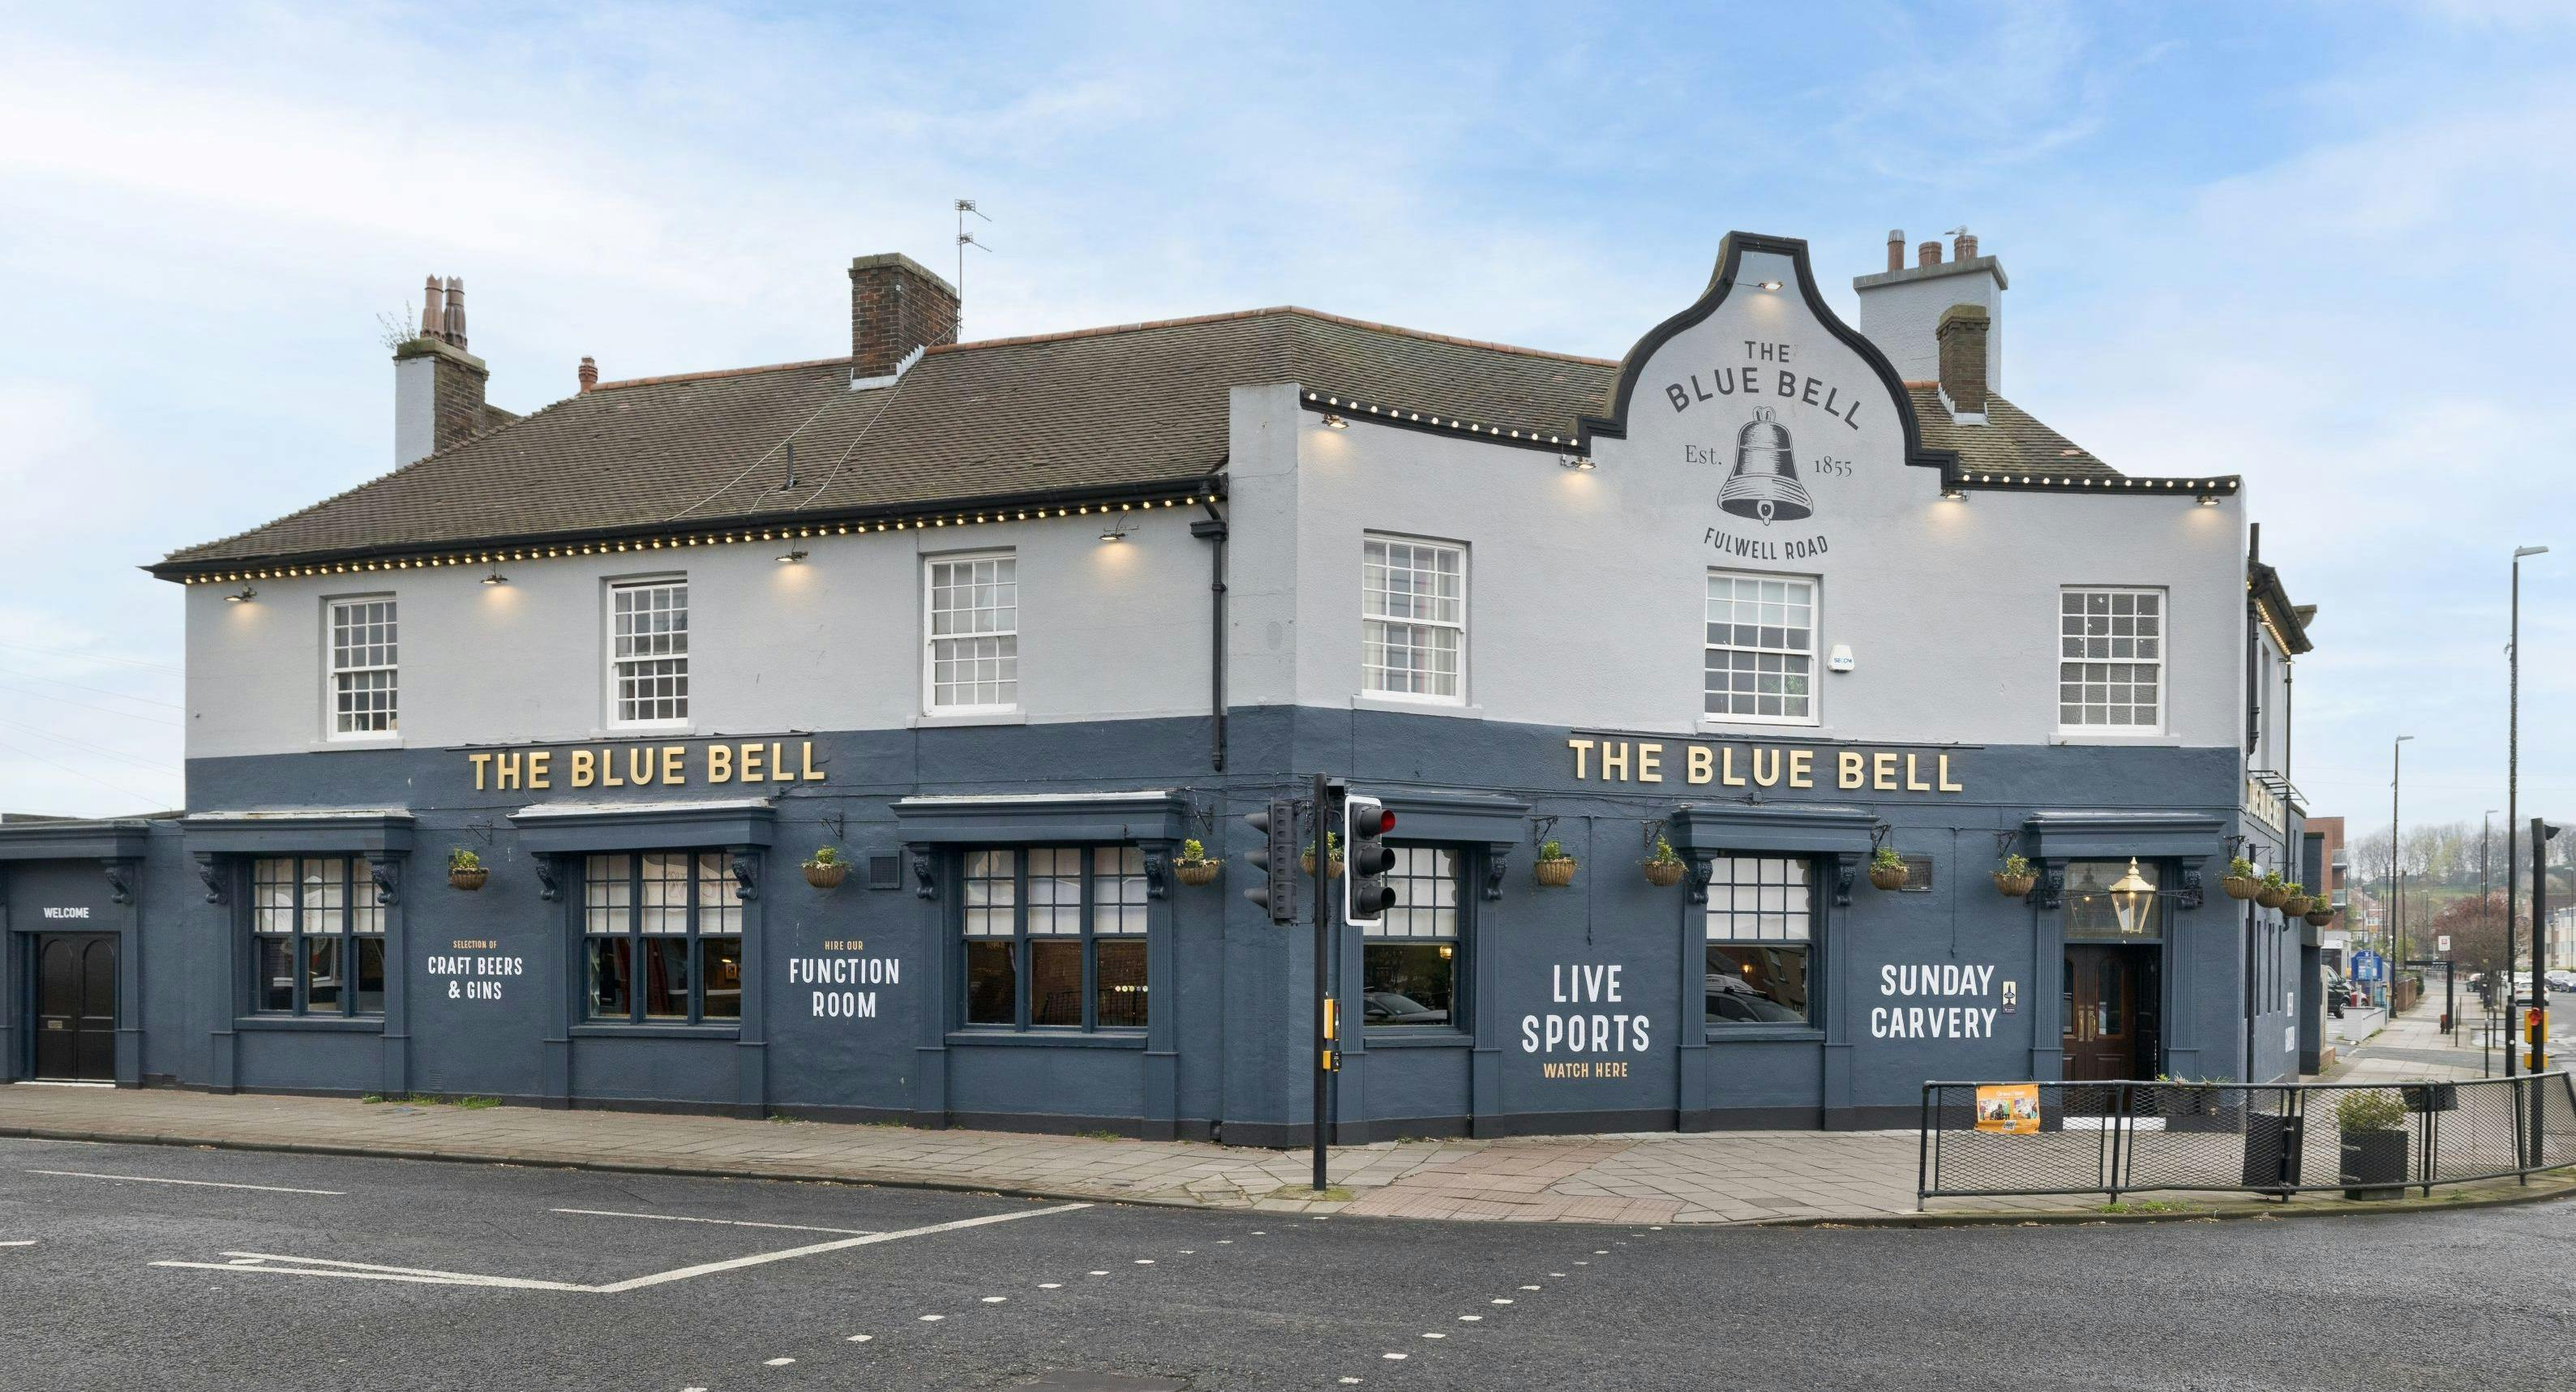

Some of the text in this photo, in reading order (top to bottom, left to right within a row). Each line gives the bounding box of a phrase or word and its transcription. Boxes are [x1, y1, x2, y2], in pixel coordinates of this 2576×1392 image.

[1744, 341, 1790, 363] THE
[1665, 366, 1863, 431] BLUE BELL
[1684, 444, 1853, 477] Est. 1855
[1704, 527, 1829, 560] FULWELL ROAD
[469, 741, 825, 790] THE BLUE BELL
[1569, 739, 1963, 791] THE BLUE BELL
[43, 907, 89, 919] WELCOME
[452, 940, 497, 949] SELECTION OF
[825, 940, 864, 951] HIRE OUR
[427, 956, 523, 975] CRAFT BEERS
[790, 958, 899, 984] FUNCTION
[1880, 964, 1995, 996] SUNDAY
[448, 980, 502, 1000] & GINS
[1554, 964, 1622, 1003] LIVE
[812, 991, 876, 1018] ROOM
[1522, 1014, 1649, 1053] SPORTS
[1871, 1007, 1997, 1039] CARVERY
[1543, 1062, 1628, 1078] WATCH HERE
